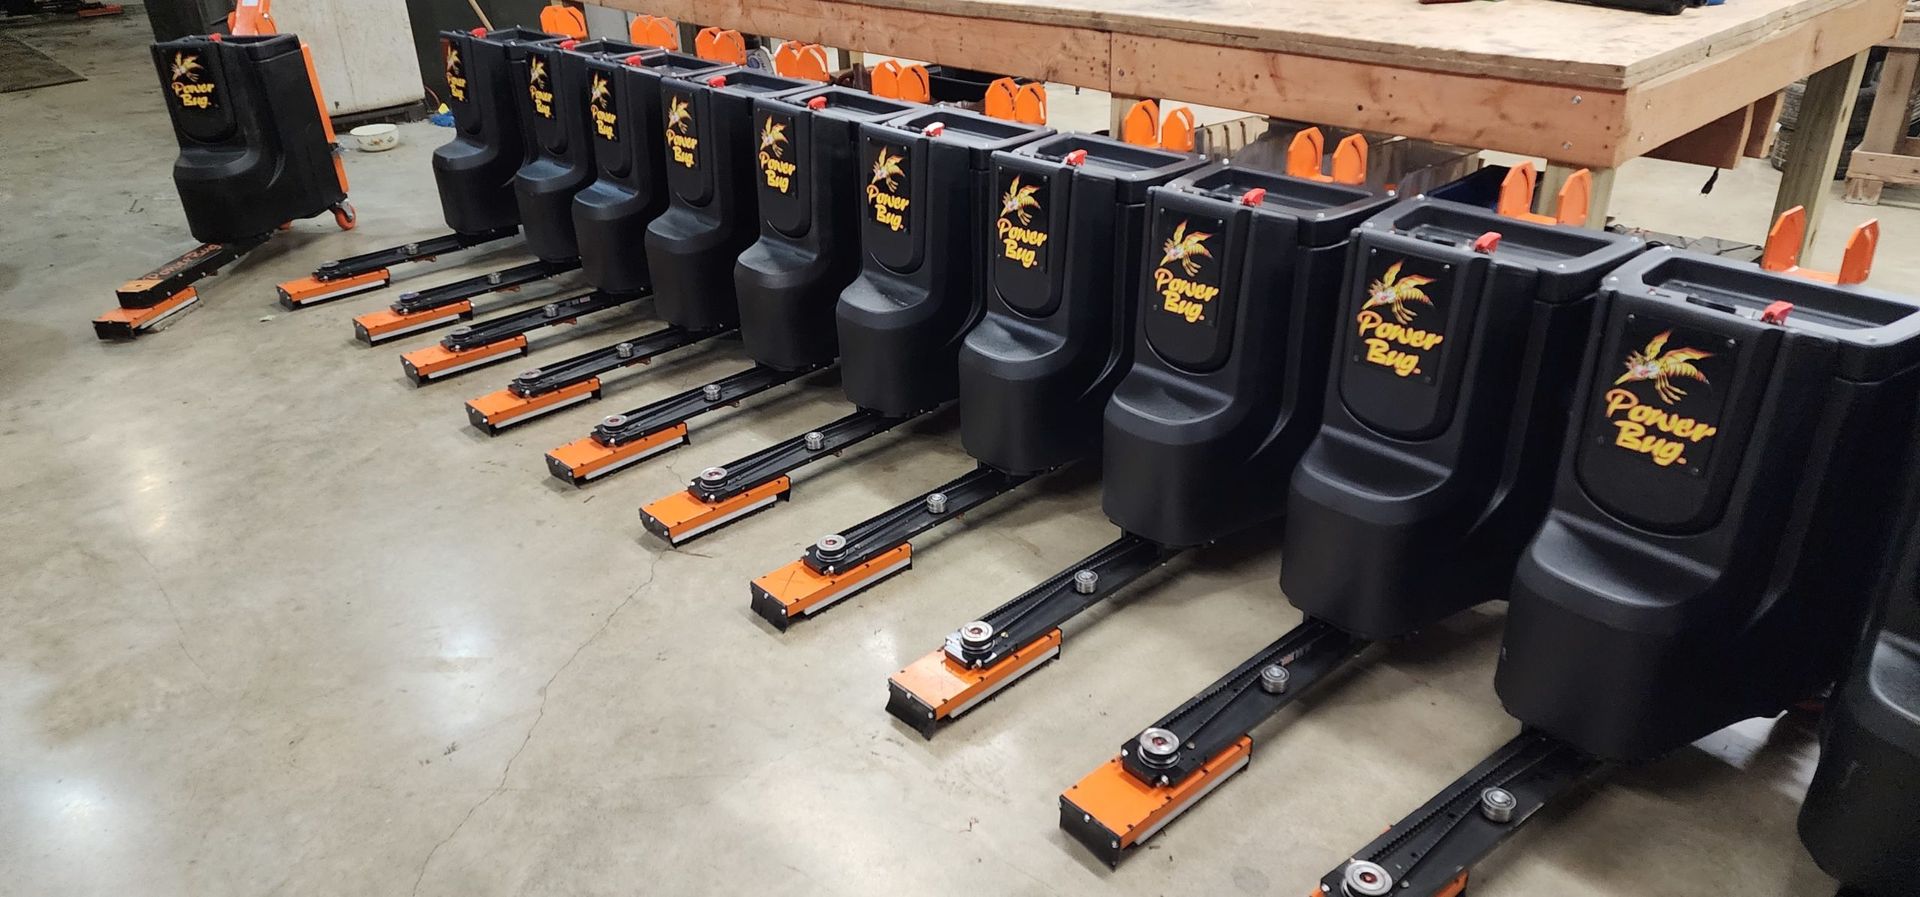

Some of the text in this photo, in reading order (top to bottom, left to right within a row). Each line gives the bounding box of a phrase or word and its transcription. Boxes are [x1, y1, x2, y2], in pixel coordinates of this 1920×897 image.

[171, 81, 215, 96] Power
[530, 85, 553, 102] Power
[591, 104, 617, 124] Power
[666, 128, 698, 149] Power
[759, 151, 796, 175] Power
[866, 184, 910, 211] Power
[997, 217, 1048, 247] Power
[1154, 267, 1219, 302] Power
[1357, 310, 1444, 351] Power
[1605, 388, 1717, 442] Power
